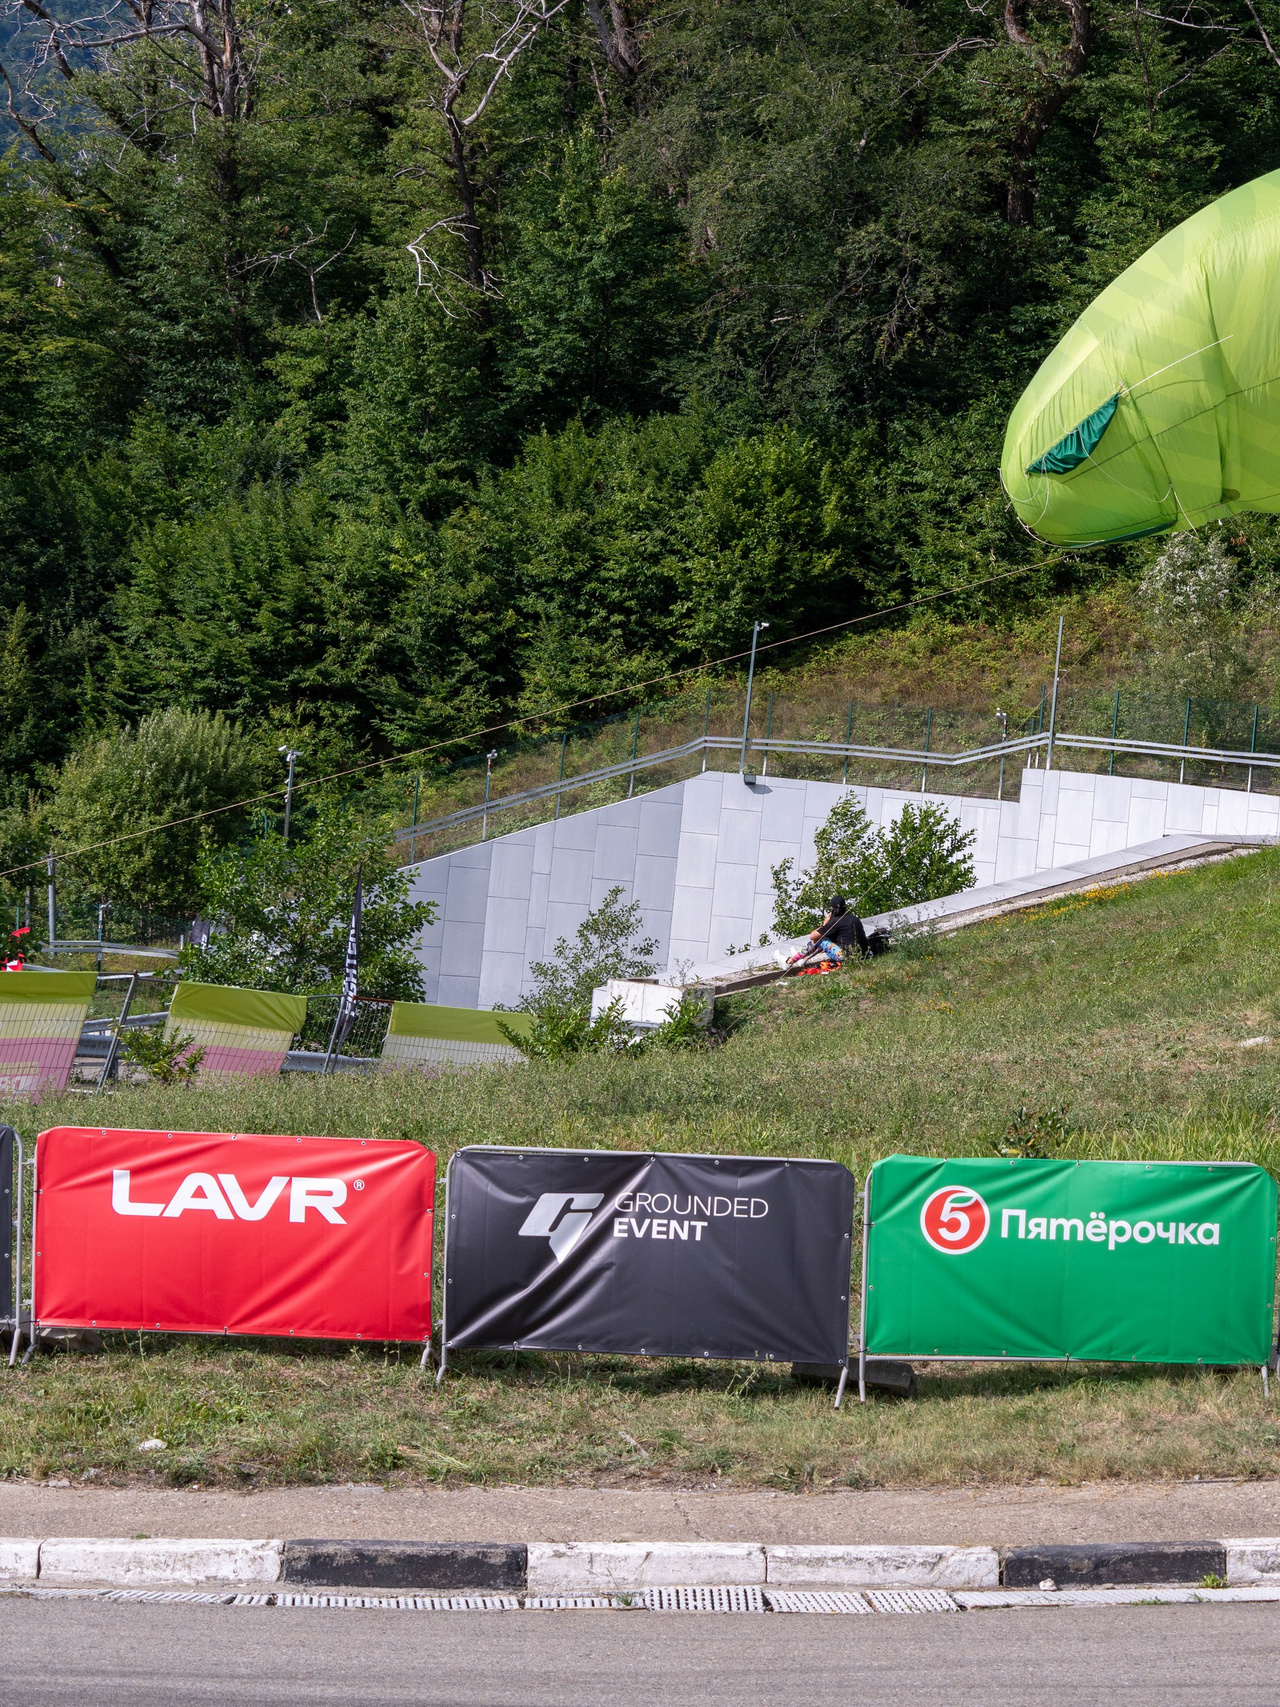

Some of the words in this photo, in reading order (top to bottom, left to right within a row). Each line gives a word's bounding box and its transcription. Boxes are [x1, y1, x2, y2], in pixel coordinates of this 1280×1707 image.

[614, 1192, 769, 1218] GROUNDED
[613, 1217, 708, 1241] EVENT
[1001, 1208, 1220, 1250] Пятёрочка
